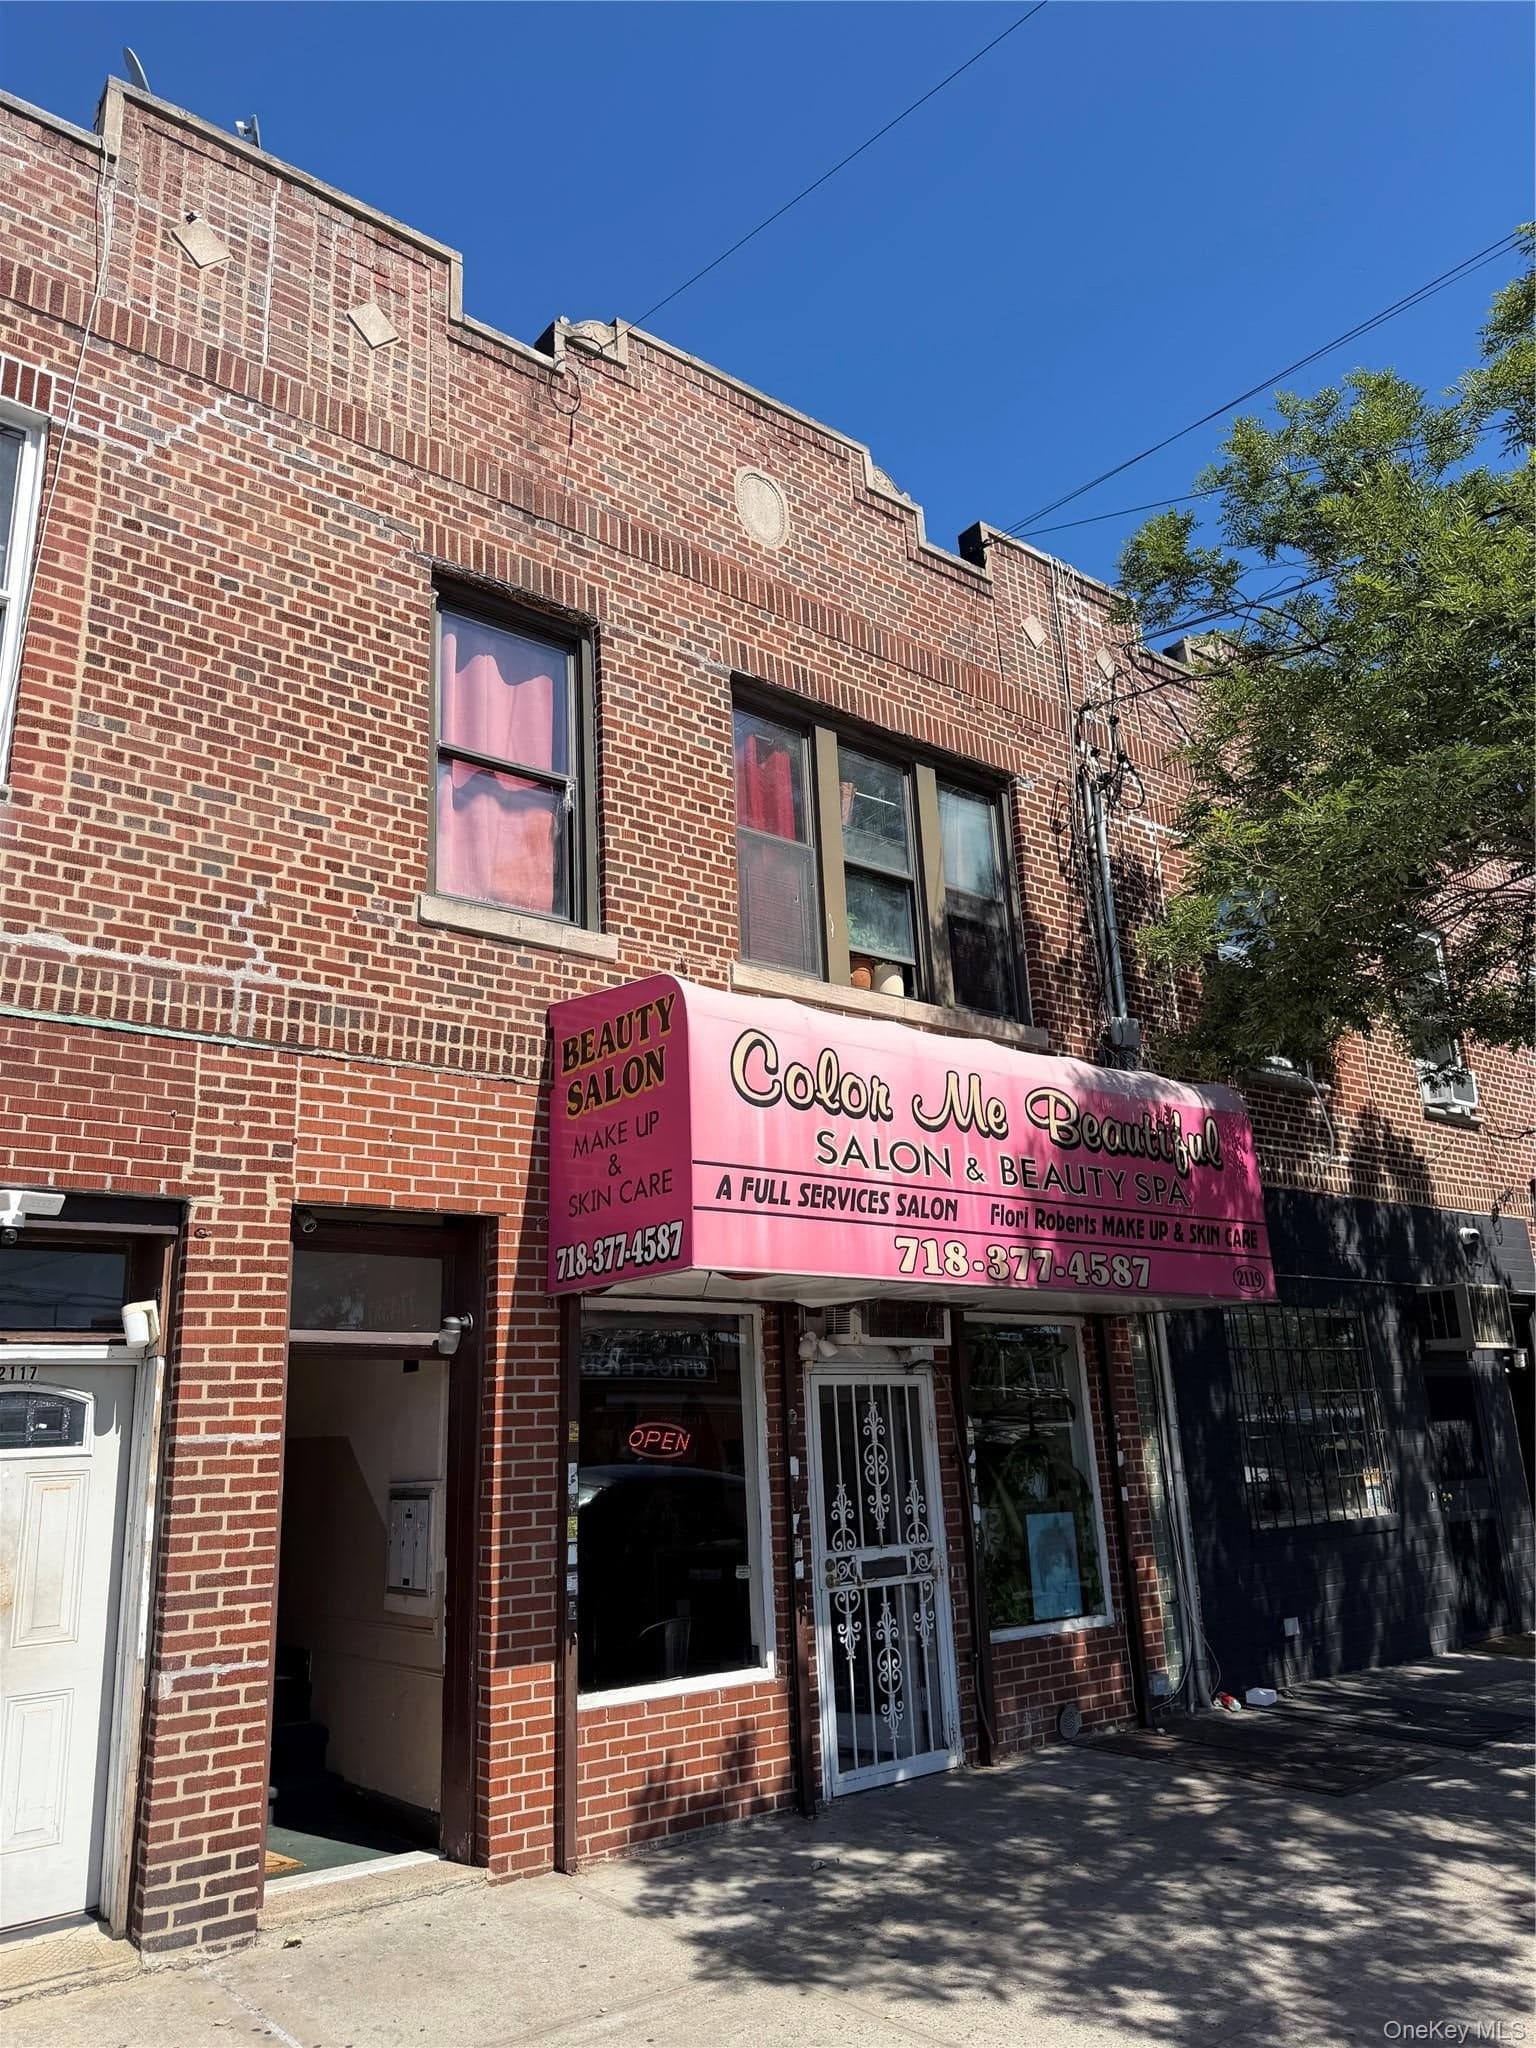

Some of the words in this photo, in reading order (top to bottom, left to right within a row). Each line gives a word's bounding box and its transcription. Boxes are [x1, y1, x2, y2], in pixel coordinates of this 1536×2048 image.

[561, 993, 676, 1076] BEAUTY
[567, 1046, 666, 1121] SALON
[730, 1028, 893, 1122] Color
[912, 1070, 1009, 1140] Me
[1025, 1086, 1224, 1179] Beautiful
[573, 1120, 628, 1159] MAKE
[636, 1110, 660, 1138] UP
[608, 1153, 622, 1176] &
[817, 1131, 951, 1178] SALON
[966, 1157, 985, 1182] &
[1001, 1155, 1125, 1200] BEAUTY
[1135, 1174, 1190, 1207] SPA
[568, 1185, 612, 1218] SKIN
[619, 1169, 673, 1202] CARE
[715, 1174, 732, 1201] A
[740, 1176, 791, 1206] FULL
[797, 1183, 889, 1215] SERVICES
[895, 1193, 958, 1222] SALON
[557, 1219, 684, 1282] 718-377-4587
[990, 1203, 1029, 1229] Flori
[1035, 1208, 1097, 1235] Roberts
[1102, 1215, 1145, 1240] MAKE
[1151, 1221, 1169, 1241] UP
[1174, 1225, 1184, 1243] &
[1190, 1225, 1220, 1246] SKIN
[1225, 1227, 1258, 1249] CARE
[894, 1235, 1151, 1289] 718-377-4587
[1237, 1270, 1262, 1287] 2119
[0, 1366, 38, 1380] 2117
[629, 1429, 691, 1451] OPEN
